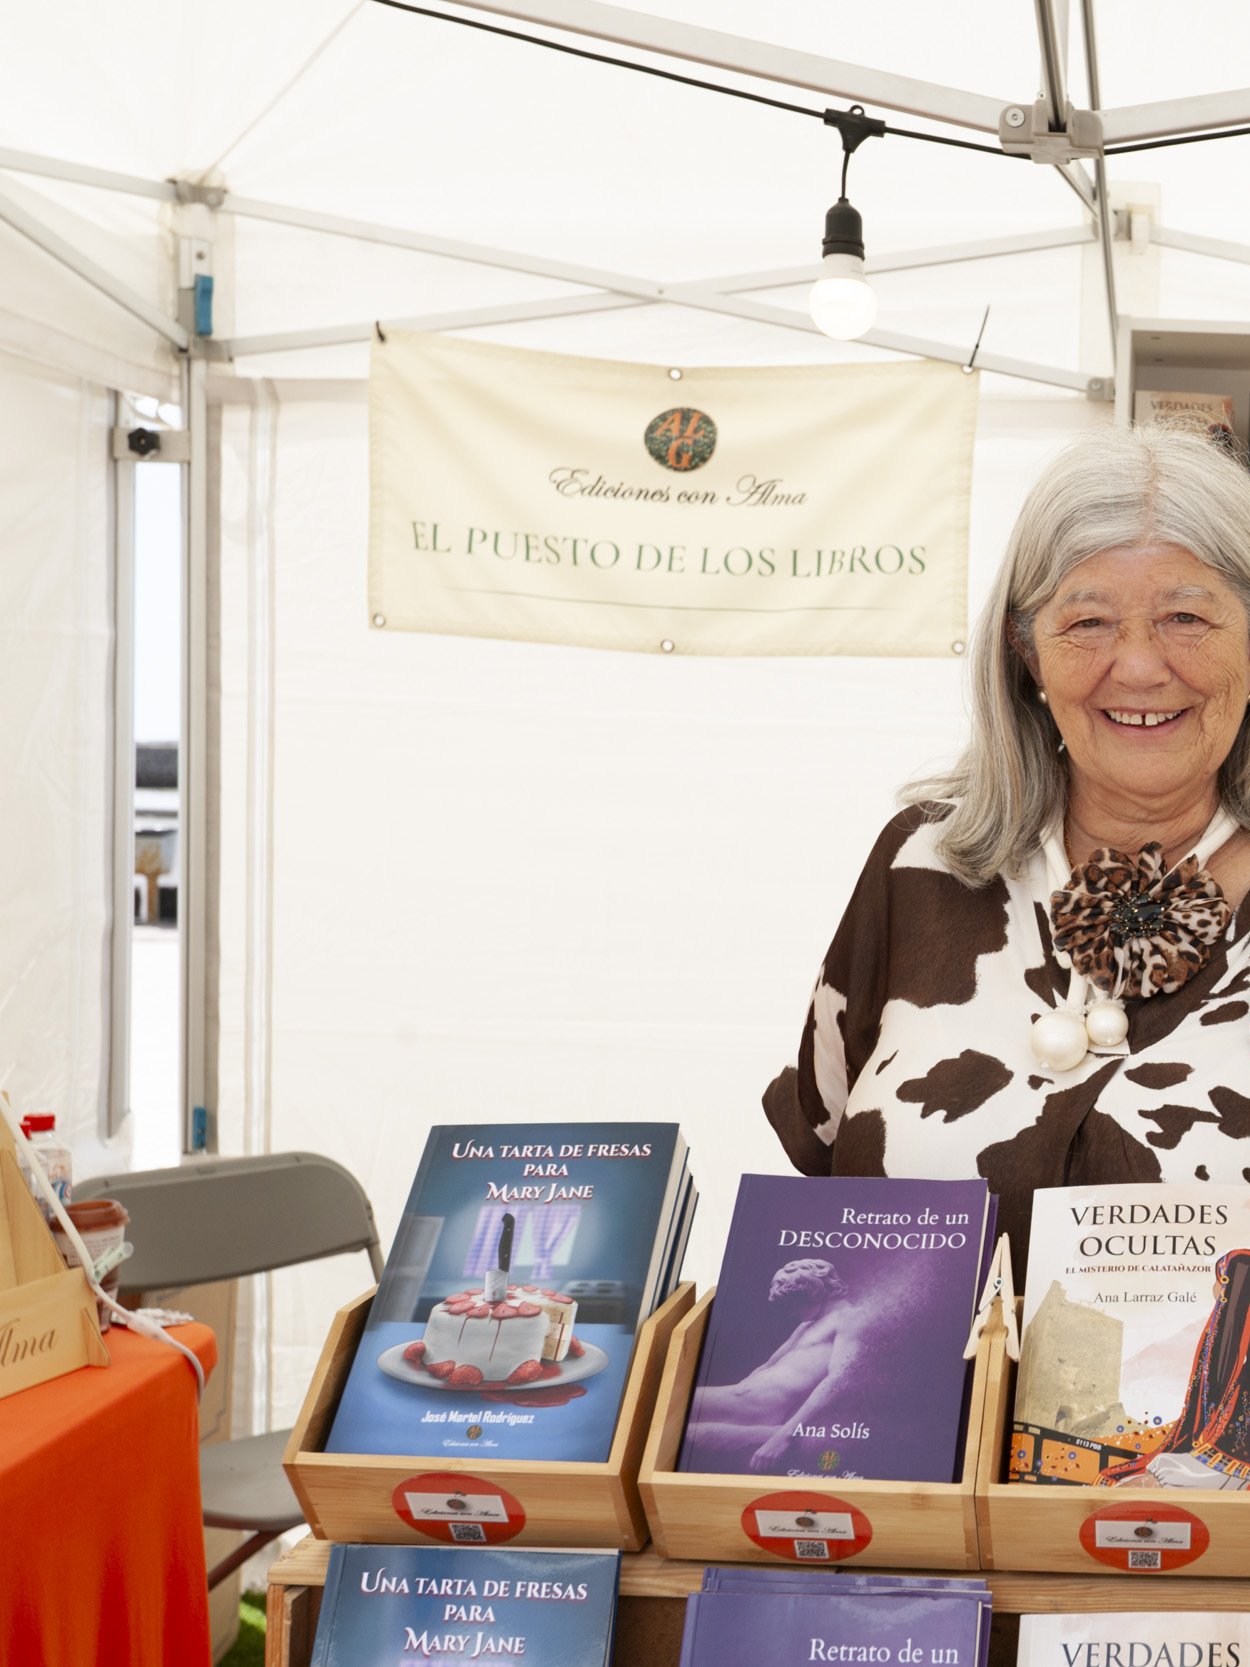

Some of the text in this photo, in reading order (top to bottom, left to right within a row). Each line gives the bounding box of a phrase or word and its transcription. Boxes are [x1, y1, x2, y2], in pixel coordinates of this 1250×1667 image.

[549, 467, 807, 507] Ediciones con Alma
[411, 521, 927, 579] EL PUESTO DE LOS LIBROS
[452, 1140, 652, 1159] UNA TARTA DE FRESAS
[523, 1163, 569, 1177] PARA
[486, 1182, 593, 1202] MARY JANE
[841, 1207, 969, 1225] Retrato de un
[1070, 1203, 1229, 1226] VERDADES
[778, 1229, 967, 1250] DESCONOCIDO
[1079, 1235, 1216, 1257] OCULTAS
[1078, 1265, 1126, 1274] MISTERIO
[1128, 1265, 1141, 1273] DE
[1142, 1262, 1212, 1274] CALATAÑAZOR
[1094, 1290, 1197, 1304] Ana Larraz Galé
[421, 1410, 535, 1426] José Martel Rodríguez
[792, 1422, 870, 1439] Ana Solís
[361, 1571, 588, 1601] UNA TARTA DE FRESAS
[444, 1604, 497, 1624] PARA
[404, 1628, 525, 1657] MARY JANE
[809, 1638, 959, 1664] Retrato de un
[1060, 1641, 1241, 1667] VERDADES
